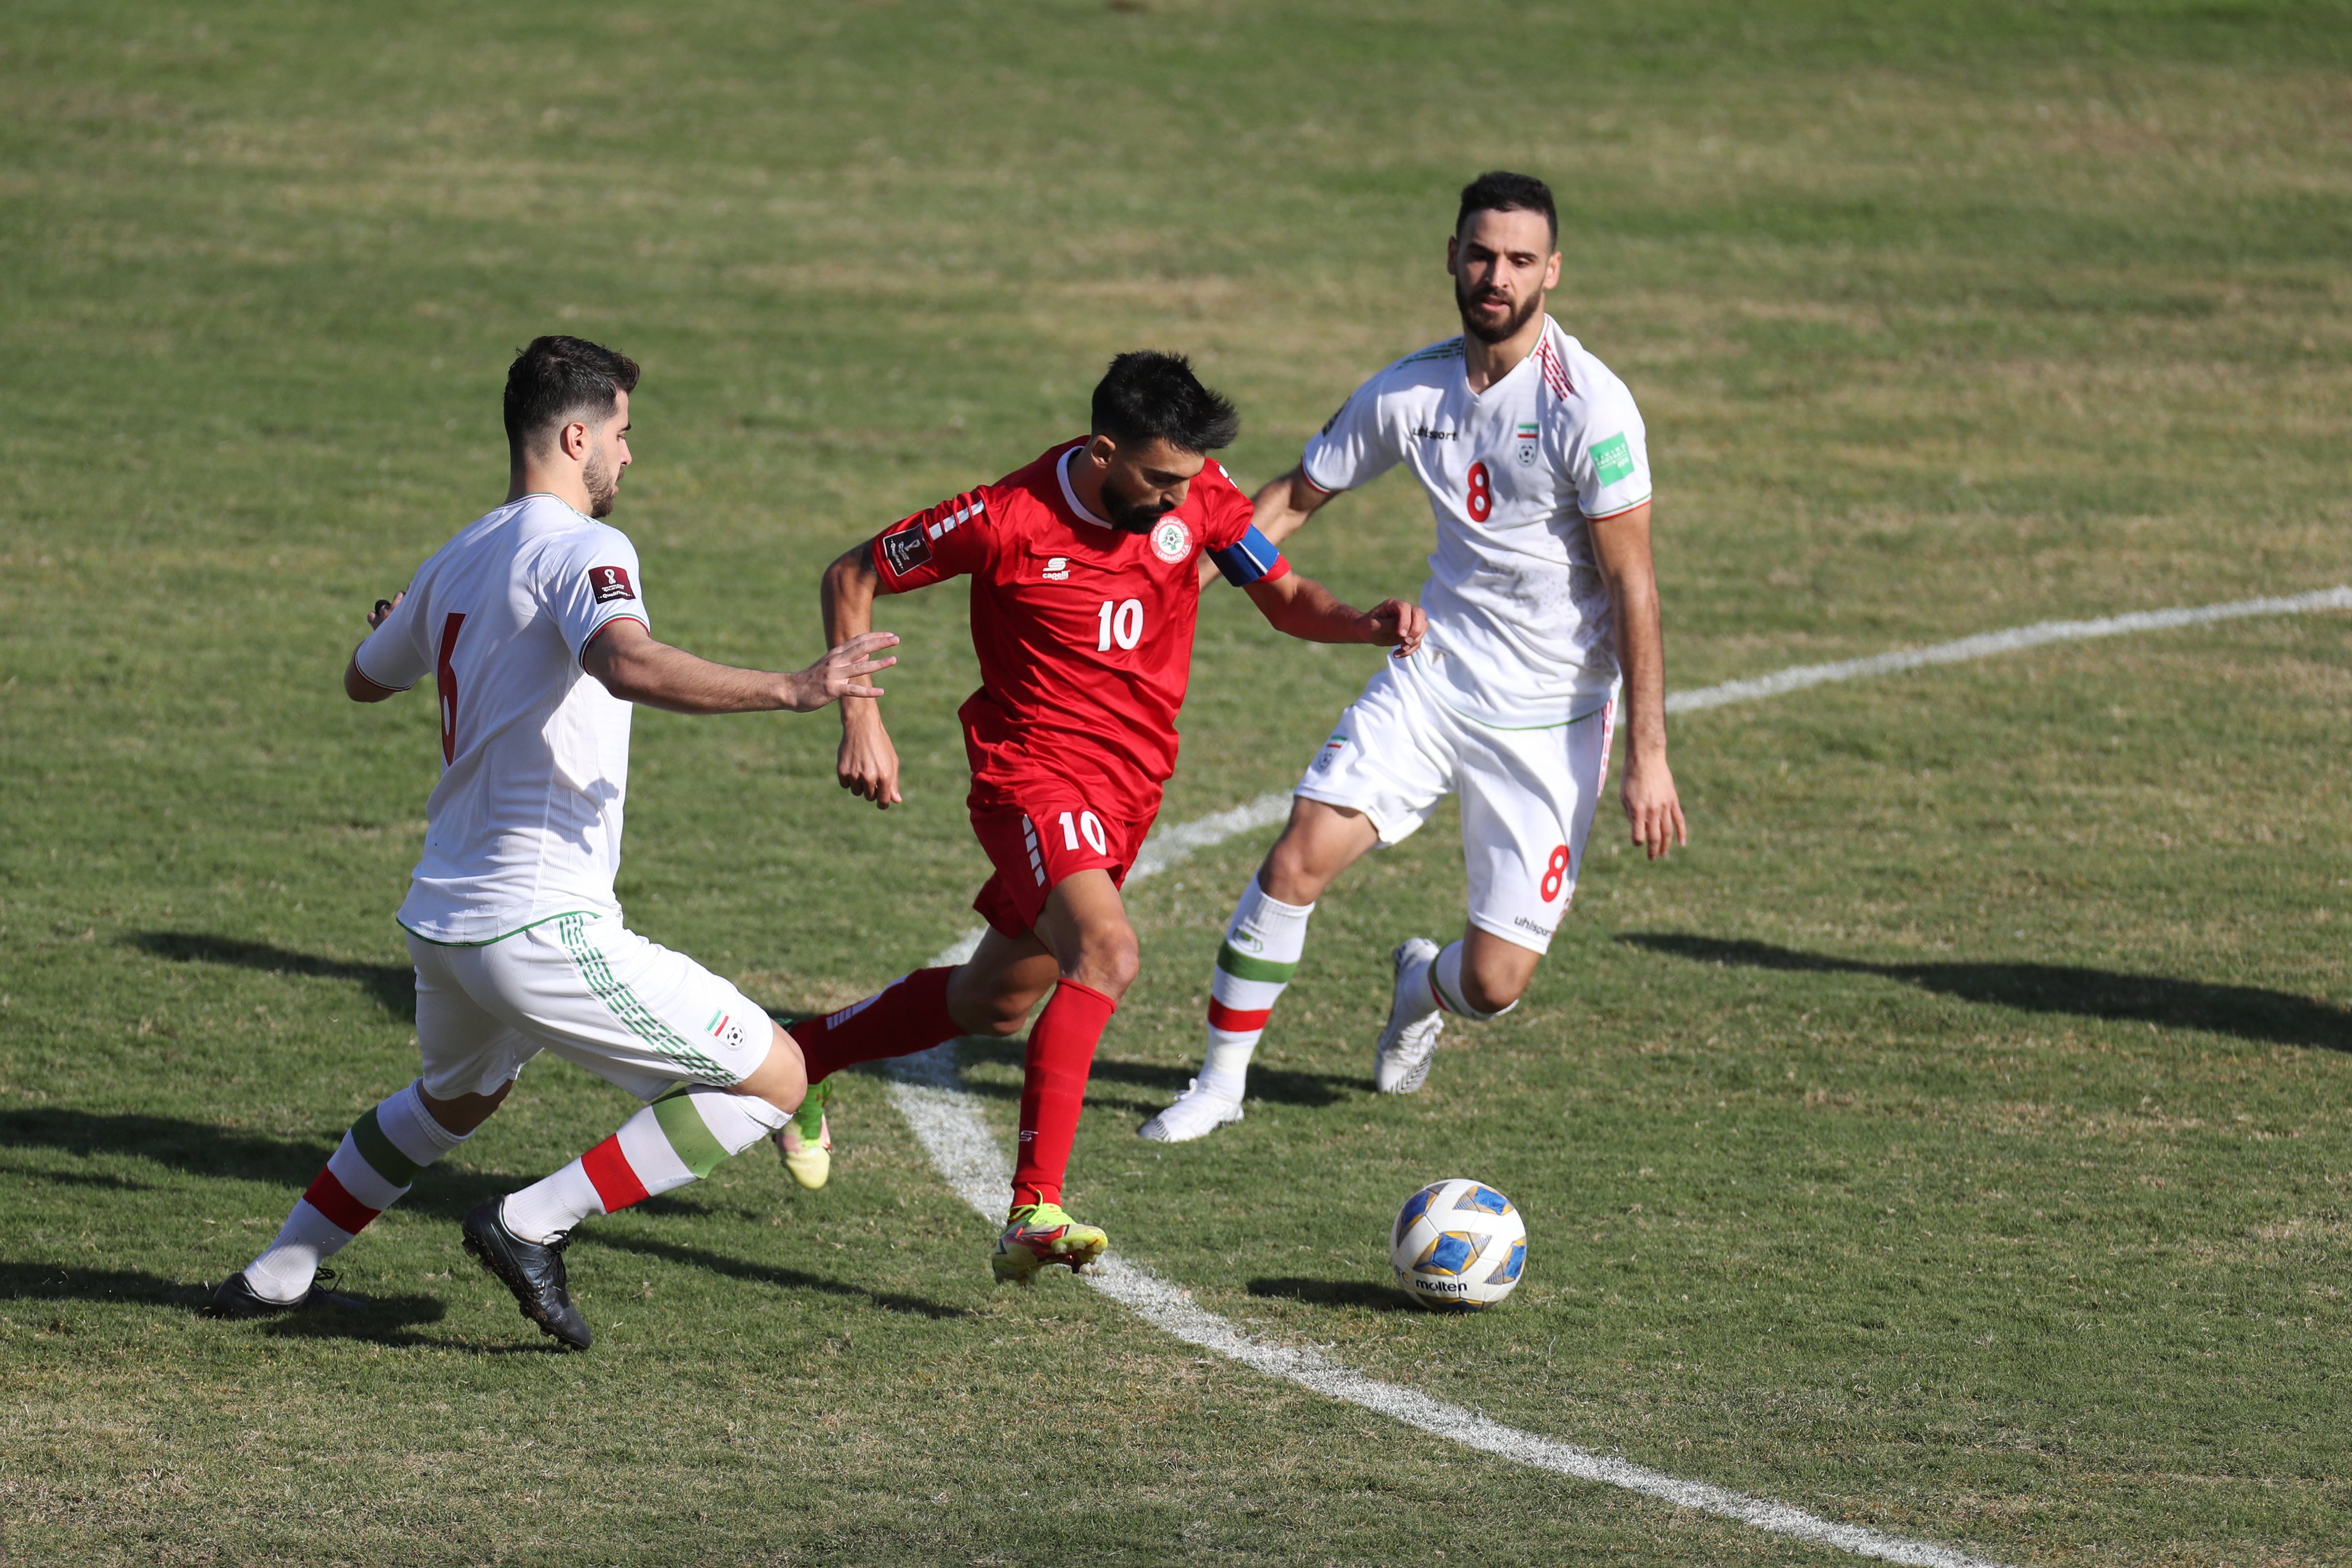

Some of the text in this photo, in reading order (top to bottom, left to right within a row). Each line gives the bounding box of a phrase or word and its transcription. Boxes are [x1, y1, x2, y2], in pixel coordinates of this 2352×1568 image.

[1467, 461, 1492, 522] 8
[1042, 570, 1069, 580] capelli
[1157, 550, 1183, 561] LEBANON
[602, 590, 628, 598] Qualifiers
[1097, 598, 1144, 652] 10
[438, 612, 466, 767] 6
[1058, 810, 1107, 856] 10
[1541, 845, 1570, 903] 8
[1416, 1279, 1467, 1292] molten
